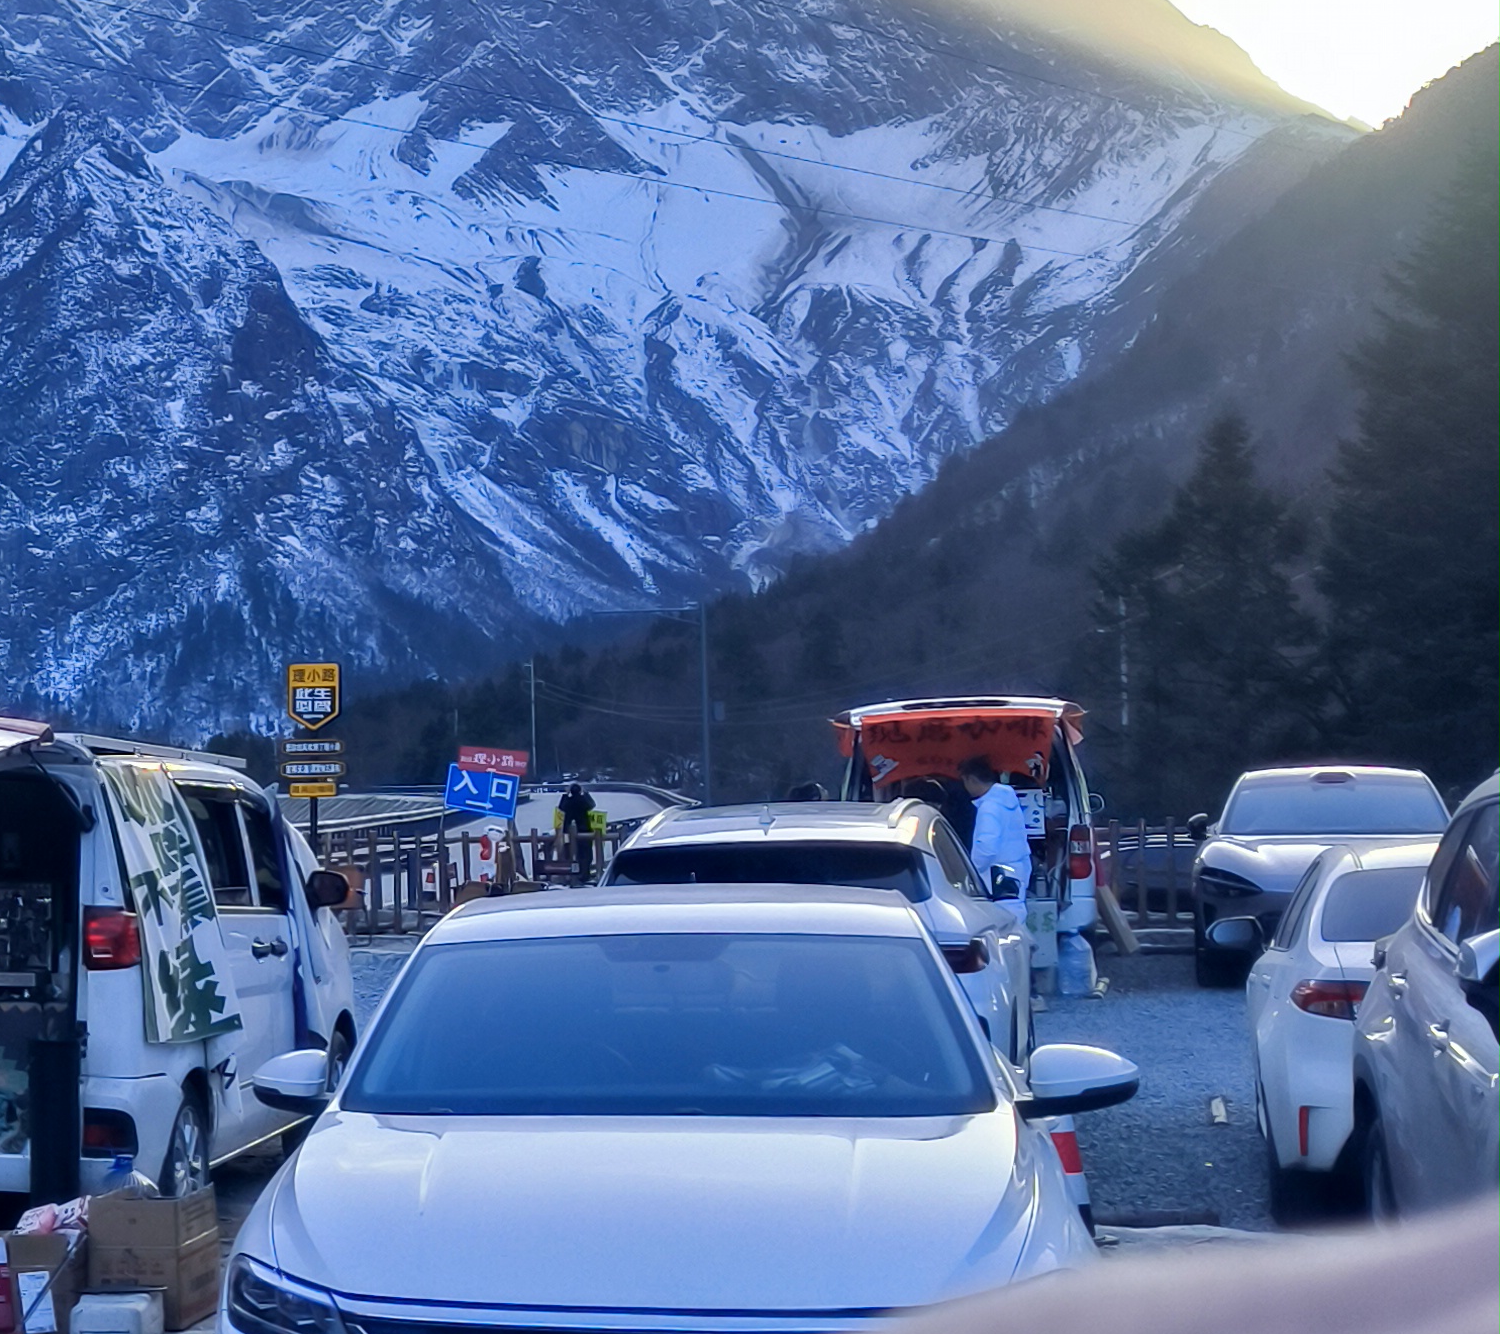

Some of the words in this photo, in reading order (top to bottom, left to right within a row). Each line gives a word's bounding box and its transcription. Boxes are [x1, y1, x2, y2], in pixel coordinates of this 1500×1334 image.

[292, 668, 336, 683] 理小路
[453, 769, 513, 801] 入口
